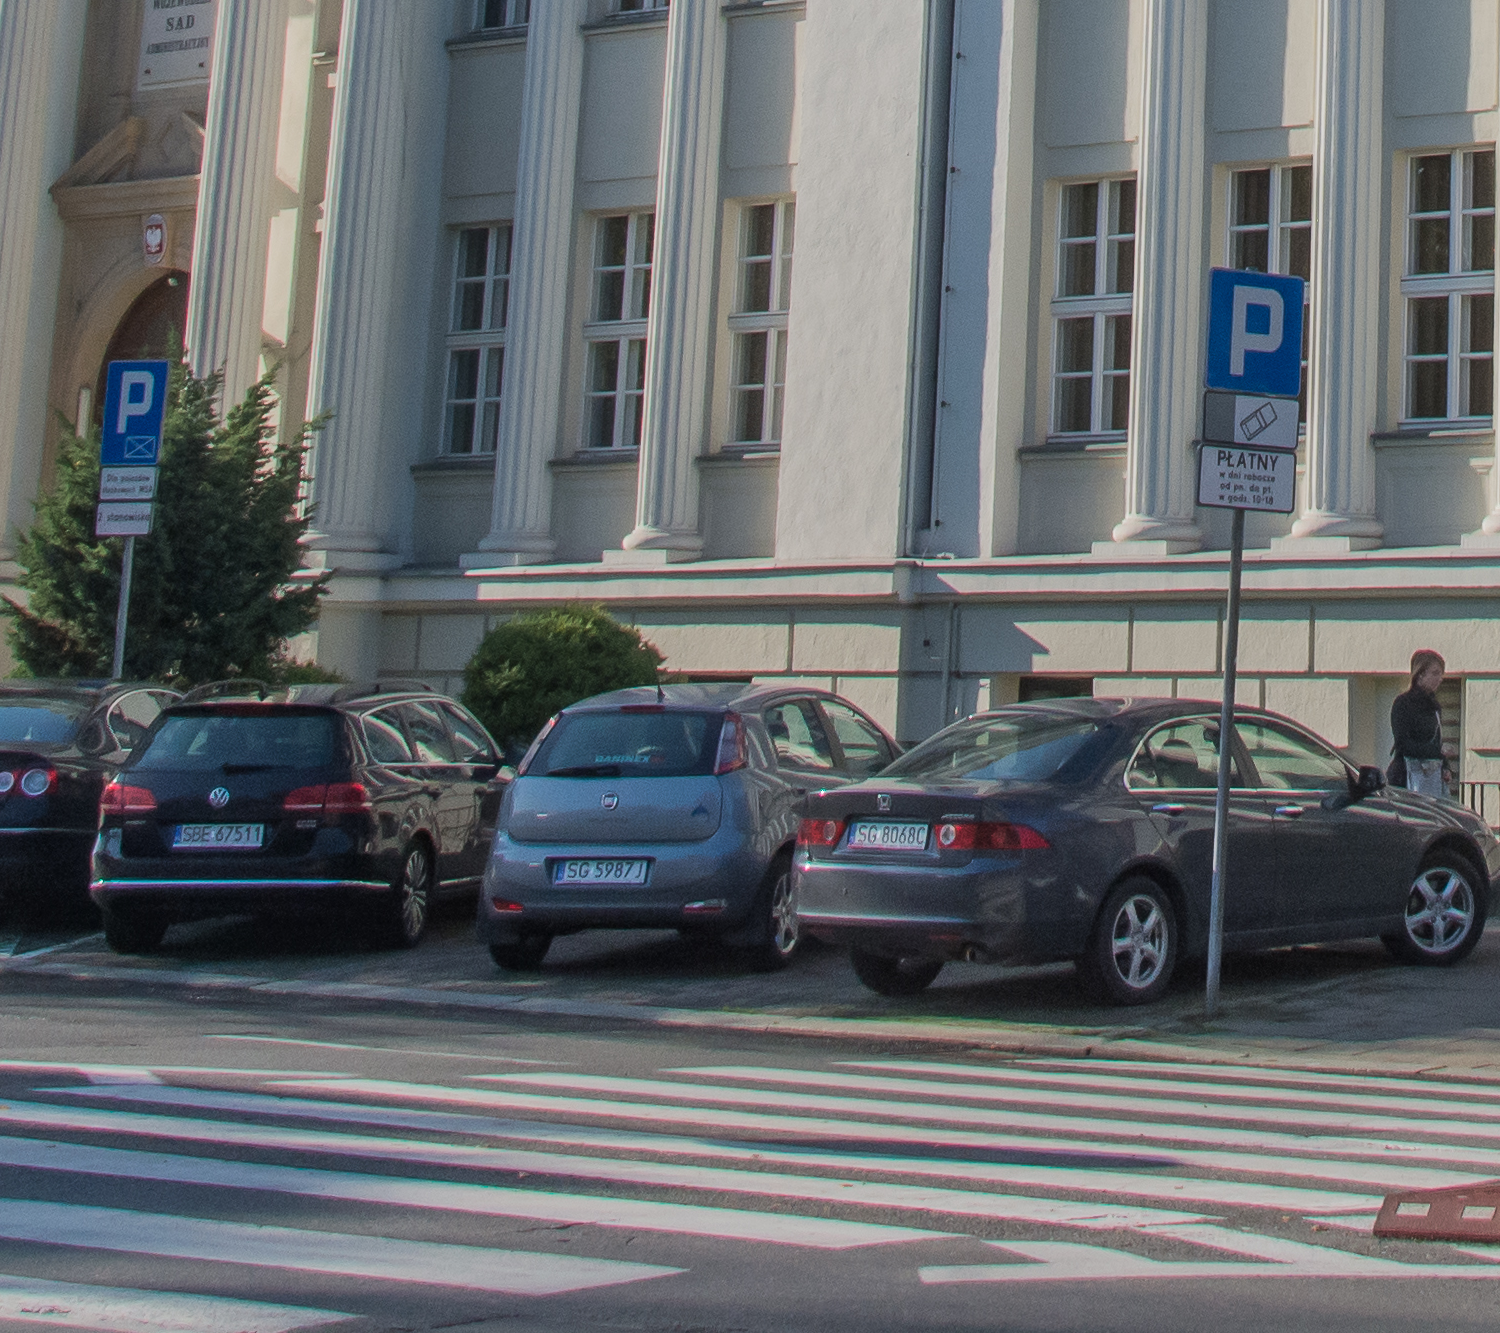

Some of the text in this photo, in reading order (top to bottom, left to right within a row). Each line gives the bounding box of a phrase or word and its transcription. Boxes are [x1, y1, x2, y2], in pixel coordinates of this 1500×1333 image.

[1229, 284, 1284, 377] P
[116, 370, 155, 434] P
[1217, 449, 1279, 472] PŁATNY
[182, 824, 262, 842] SBE 67511
[857, 823, 925, 845] SG 8068C
[567, 861, 643, 879] SG 5987J
